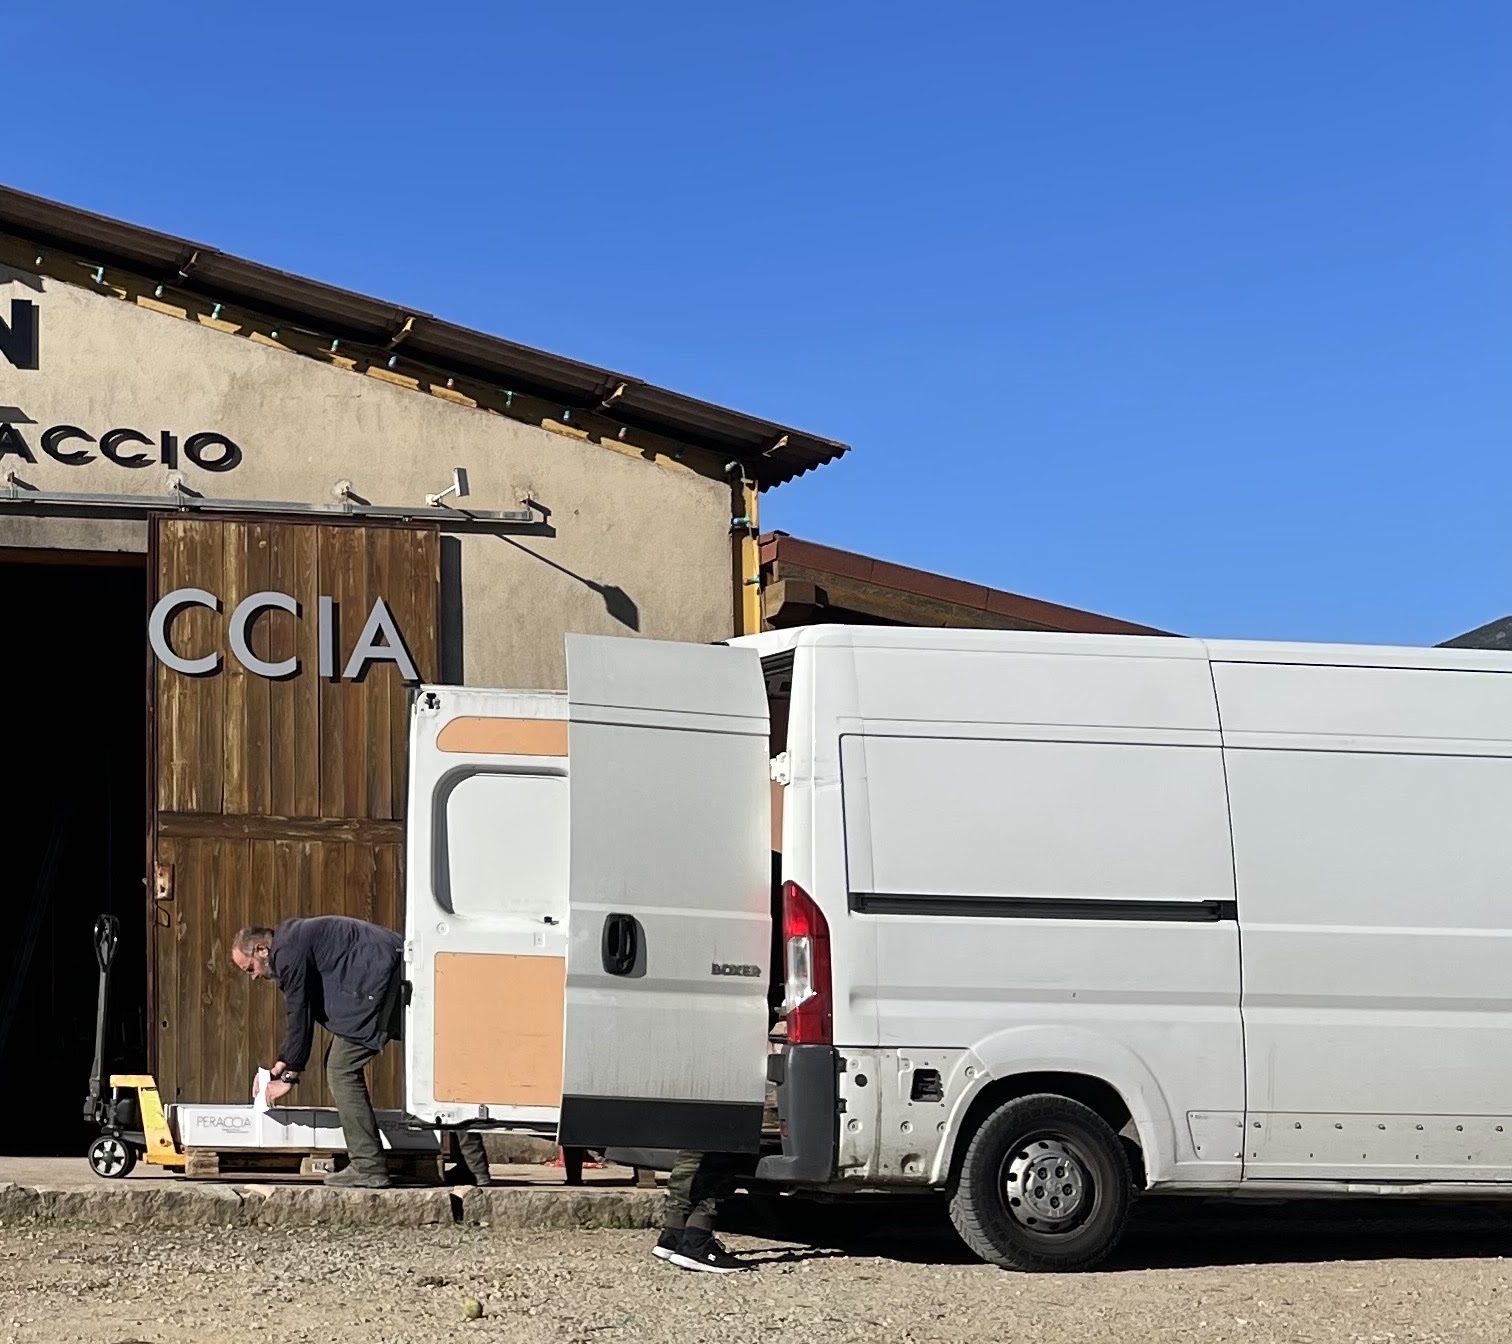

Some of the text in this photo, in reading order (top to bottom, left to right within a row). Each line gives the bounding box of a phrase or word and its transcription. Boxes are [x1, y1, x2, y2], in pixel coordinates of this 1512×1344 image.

[149, 588, 418, 680] CCIA
[711, 963, 761, 977] BOXER
[196, 1116, 252, 1128] PERACCIA
